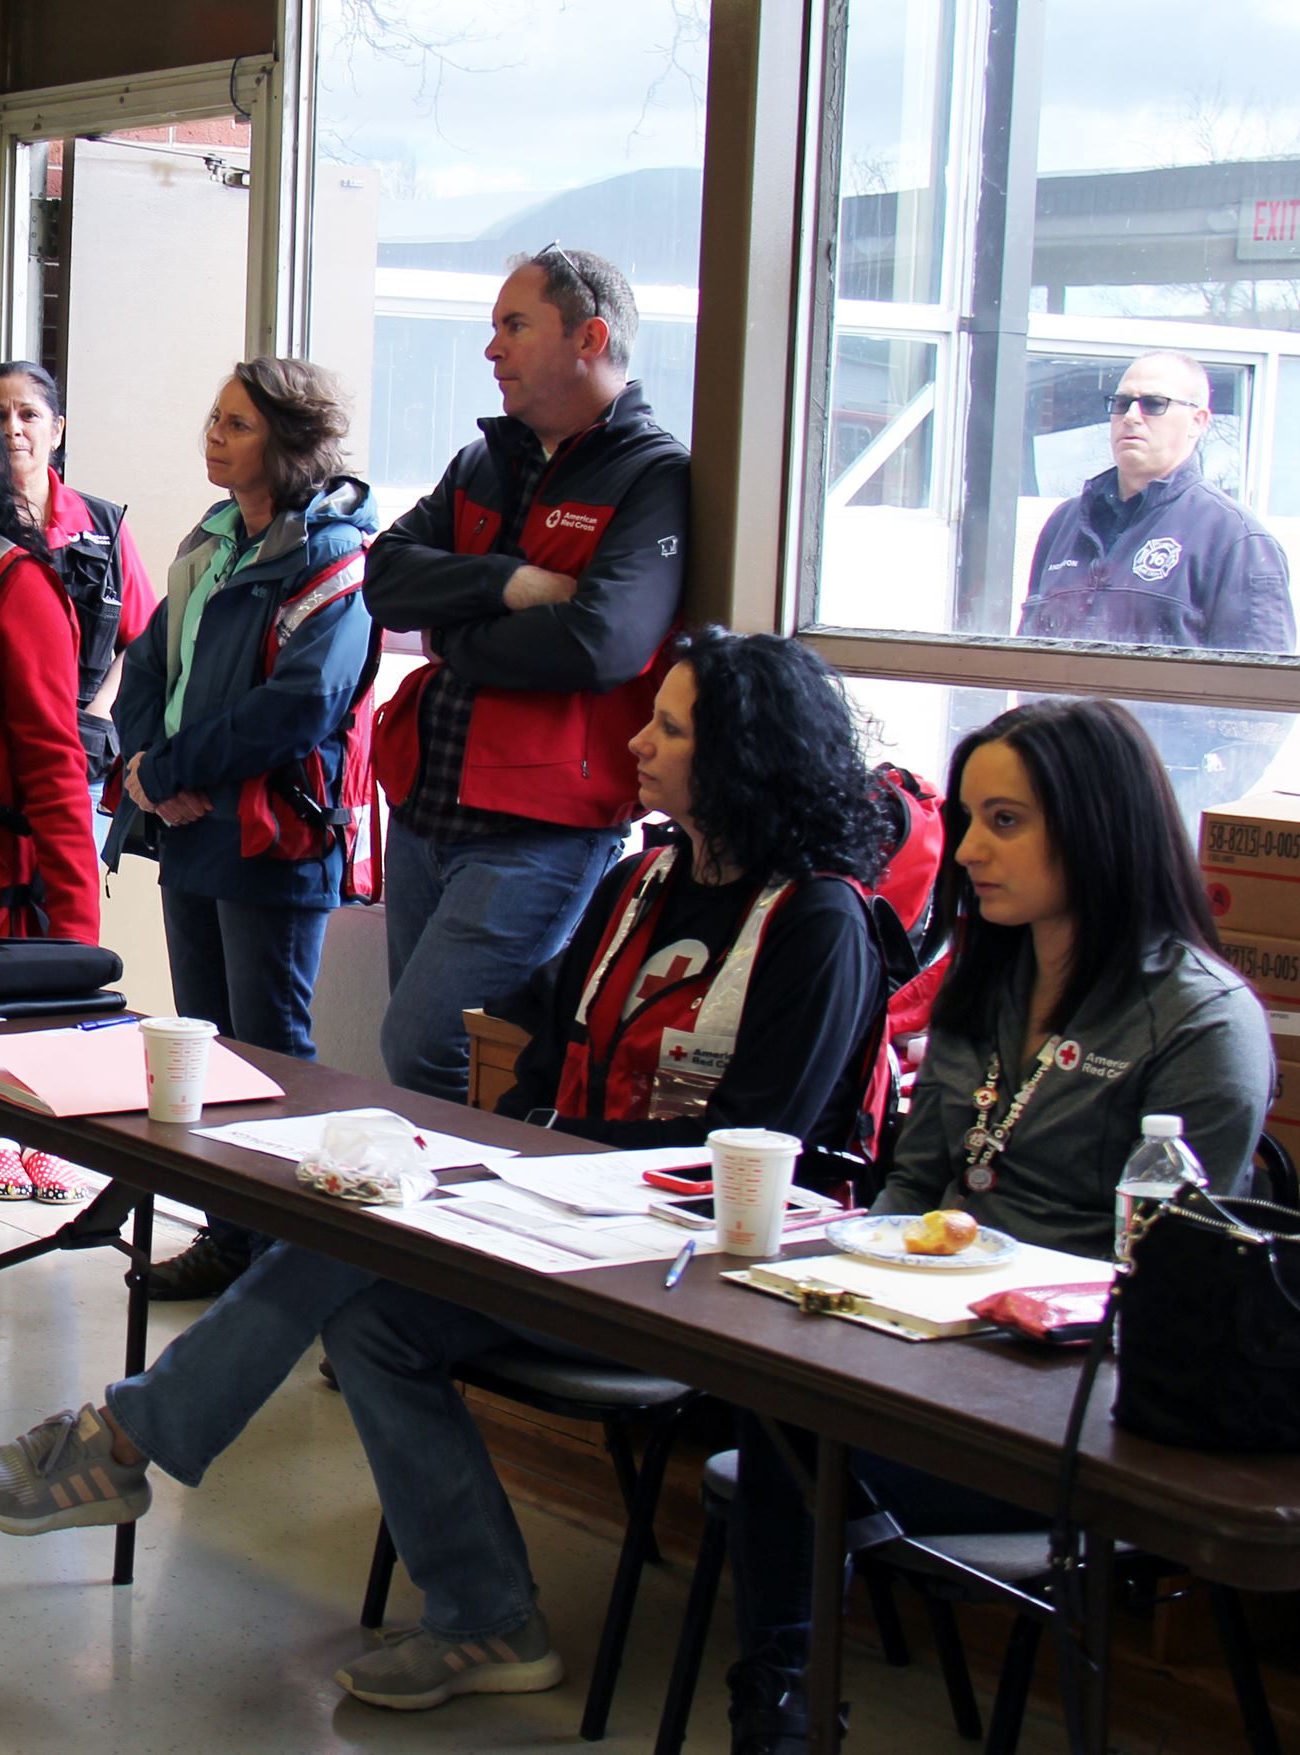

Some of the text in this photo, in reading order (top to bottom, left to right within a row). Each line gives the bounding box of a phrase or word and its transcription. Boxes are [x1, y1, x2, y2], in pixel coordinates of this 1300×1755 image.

[1253, 200, 1300, 241] EXIT
[563, 512, 598, 524] American
[560, 519, 595, 532] Red Cross
[1149, 551, 1168, 567] 16
[692, 1056, 714, 1067] Red
[1082, 1062, 1105, 1077] Red
